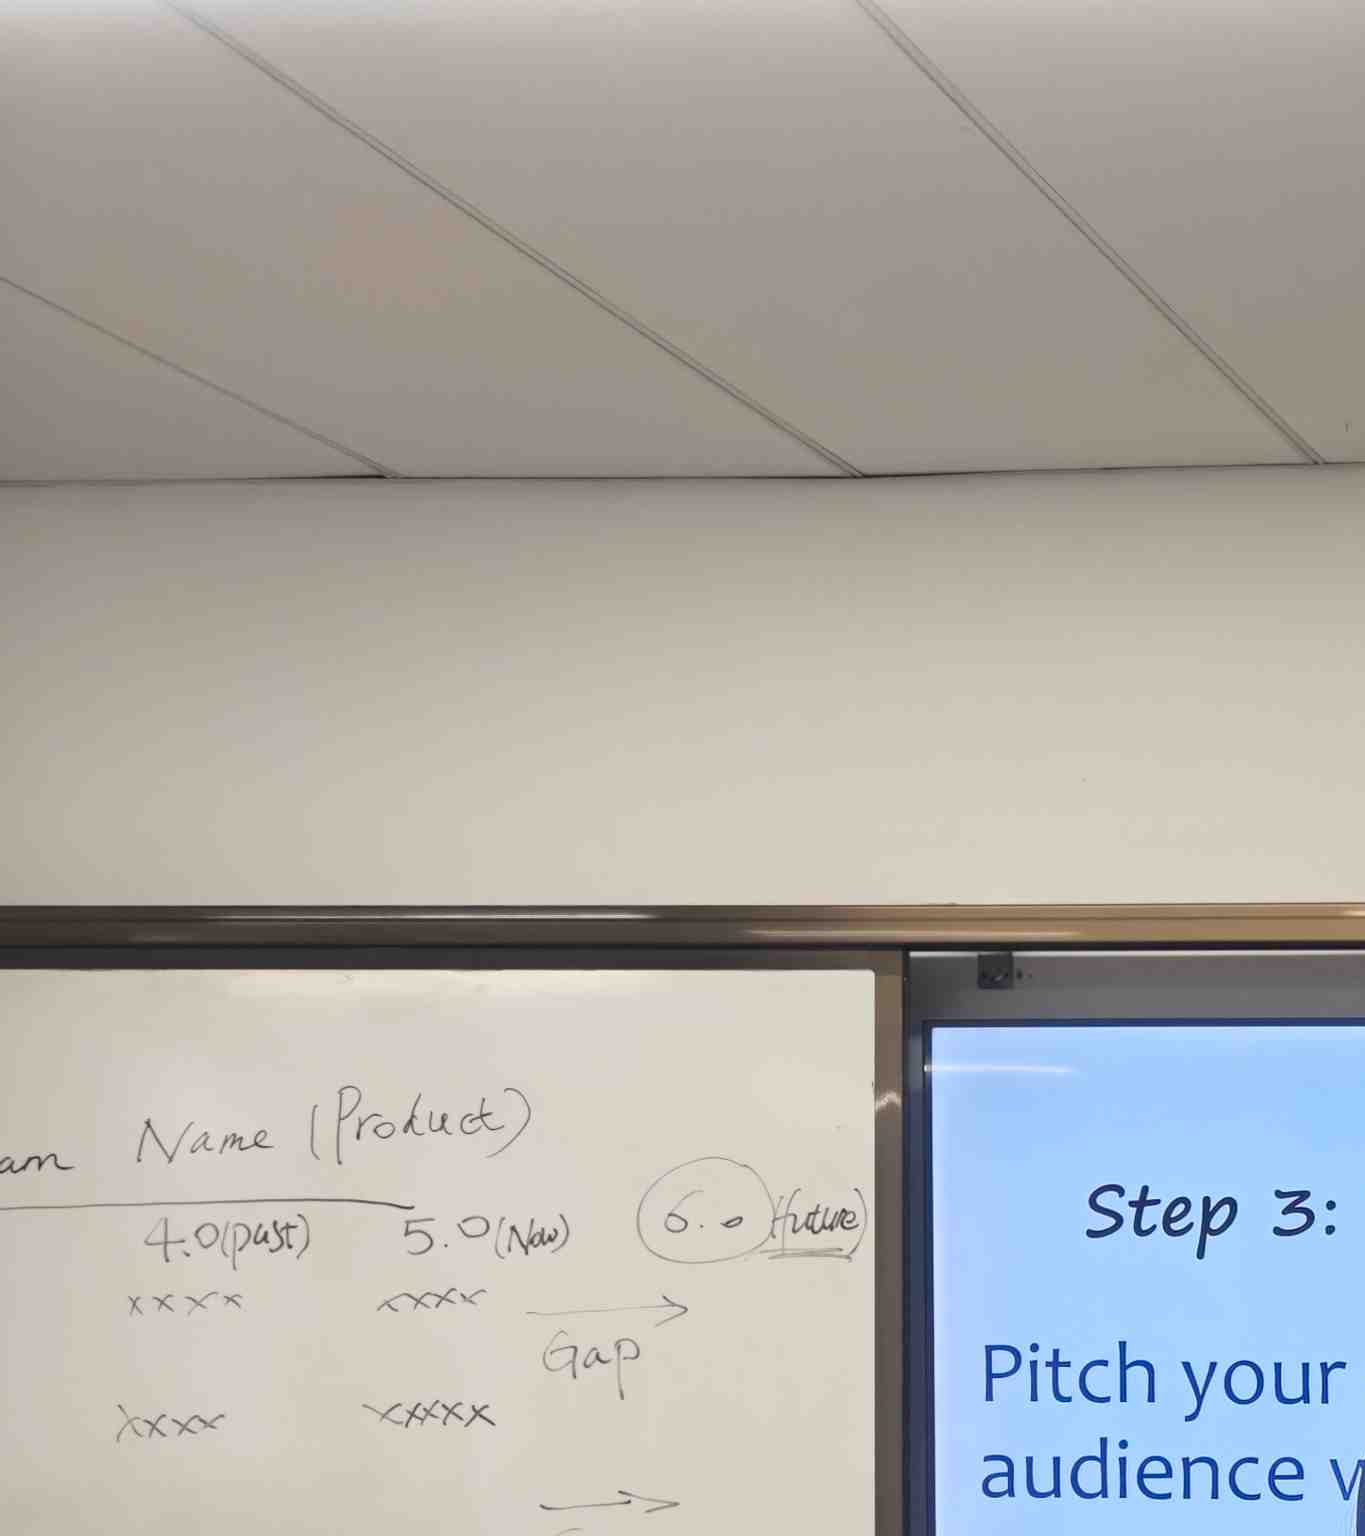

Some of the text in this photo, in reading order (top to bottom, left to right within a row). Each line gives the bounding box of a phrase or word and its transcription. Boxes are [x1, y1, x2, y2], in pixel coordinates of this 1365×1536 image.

[136, 1118, 275, 1164] Name
[310, 1085, 531, 1165] (Product)
[1086, 1184, 1238, 1260] Step
[1272, 1189, 1336, 1237] 3:
[542, 1330, 640, 1400] Gap
[984, 1341, 1155, 1403] Pitch
[1181, 1360, 1347, 1424] your
[982, 1436, 1304, 1501] audience
